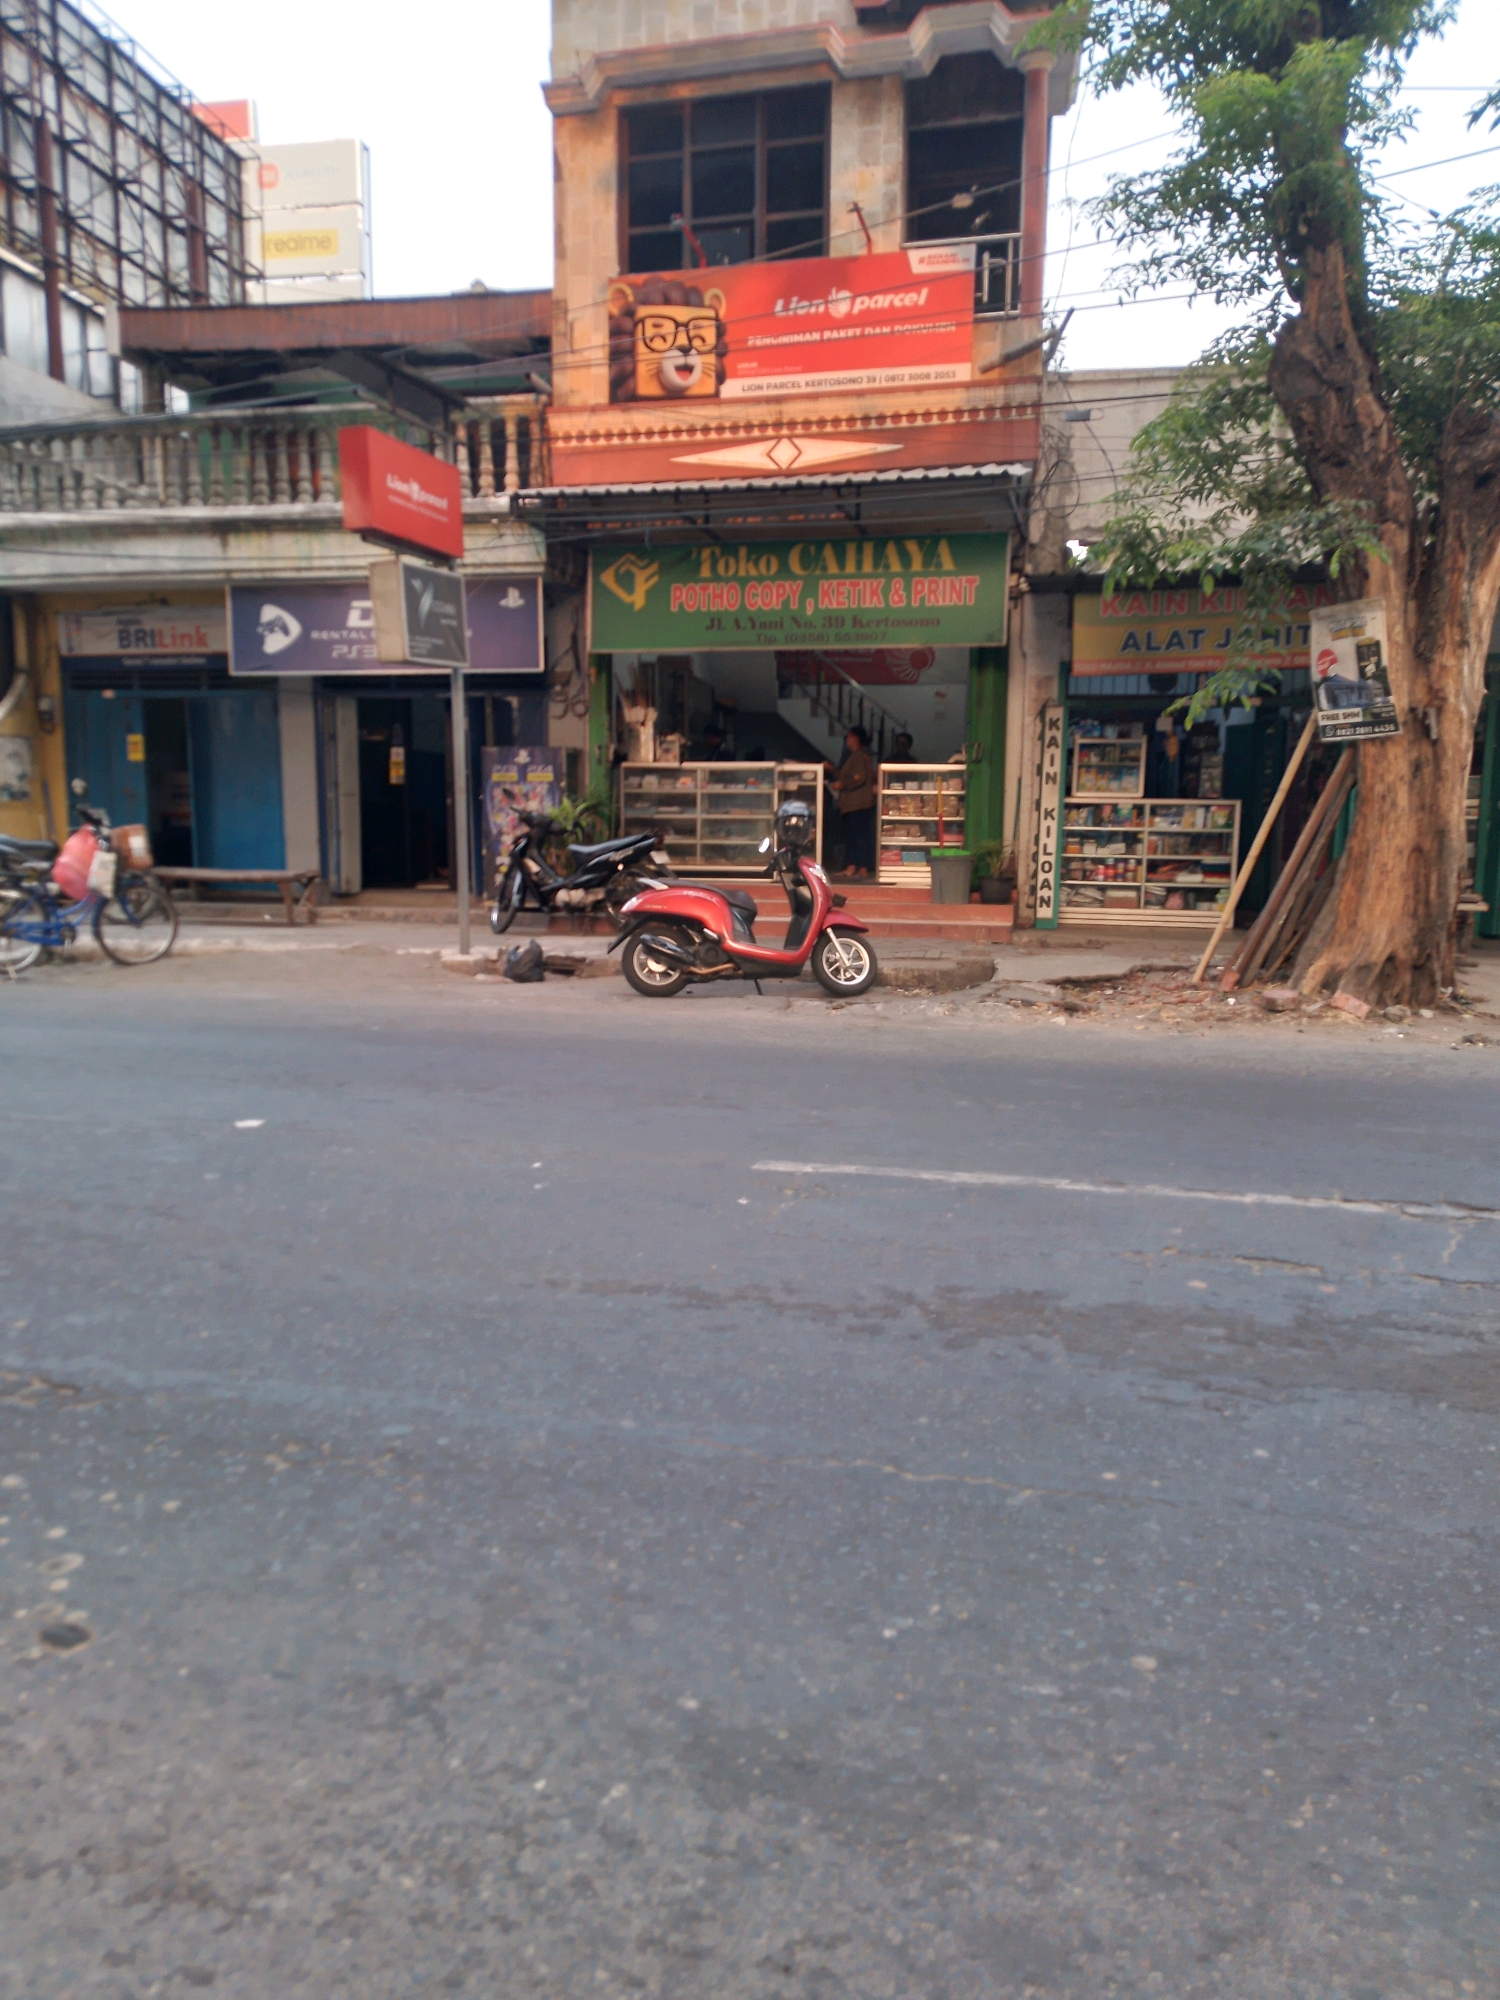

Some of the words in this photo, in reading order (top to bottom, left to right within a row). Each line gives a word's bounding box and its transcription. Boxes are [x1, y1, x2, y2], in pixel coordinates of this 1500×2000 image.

[774, 296, 825, 317] Lion
[852, 287, 929, 314] parcel
[747, 330, 821, 347] PENGIRIMAN
[823, 327, 862, 341] PAKET
[864, 325, 891, 336] DAN
[894, 321, 956, 335] DOKUMEN
[742, 383, 764, 392] LION
[766, 380, 803, 391] PARCEL
[805, 376, 863, 388] KERTOSONO
[866, 375, 877, 384] 39
[884, 373, 905, 383] 0812
[908, 371, 932, 381] 3008
[934, 370, 956, 379] 2053
[690, 545, 780, 578] Toko
[789, 538, 957, 576] CAHAYA
[670, 581, 741, 613] POTHO
[744, 580, 803, 611] COPY
[818, 578, 885, 610] KETIK
[889, 576, 906, 608] &
[911, 575, 980, 607] PRINT
[1100, 592, 1189, 618] KAIN
[822, 615, 846, 629] 39
[852, 614, 941, 628] Kertosono
[118, 625, 209, 649] BRILink
[311, 630, 368, 640] RENTAL
[1120, 627, 1207, 653] ALAT
[1321, 712, 1340, 721] FREE
[1045, 717, 1061, 786] KAIN
[1039, 806, 1056, 909] KILOAN
